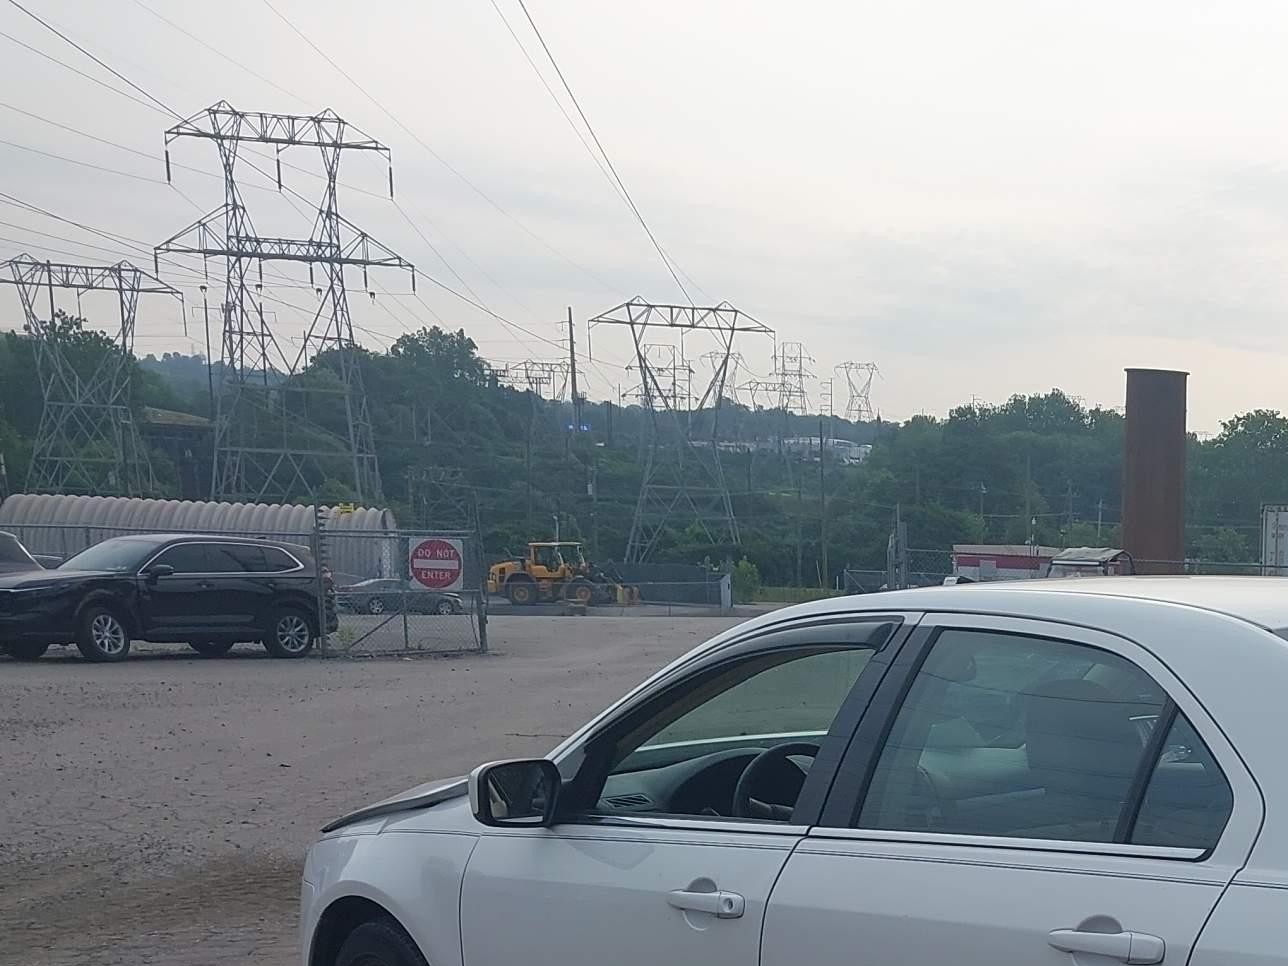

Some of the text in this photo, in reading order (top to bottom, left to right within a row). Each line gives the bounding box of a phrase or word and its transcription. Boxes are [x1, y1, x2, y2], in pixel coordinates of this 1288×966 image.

[418, 549, 455, 558] DO NOT
[422, 571, 452, 580] ENTER
